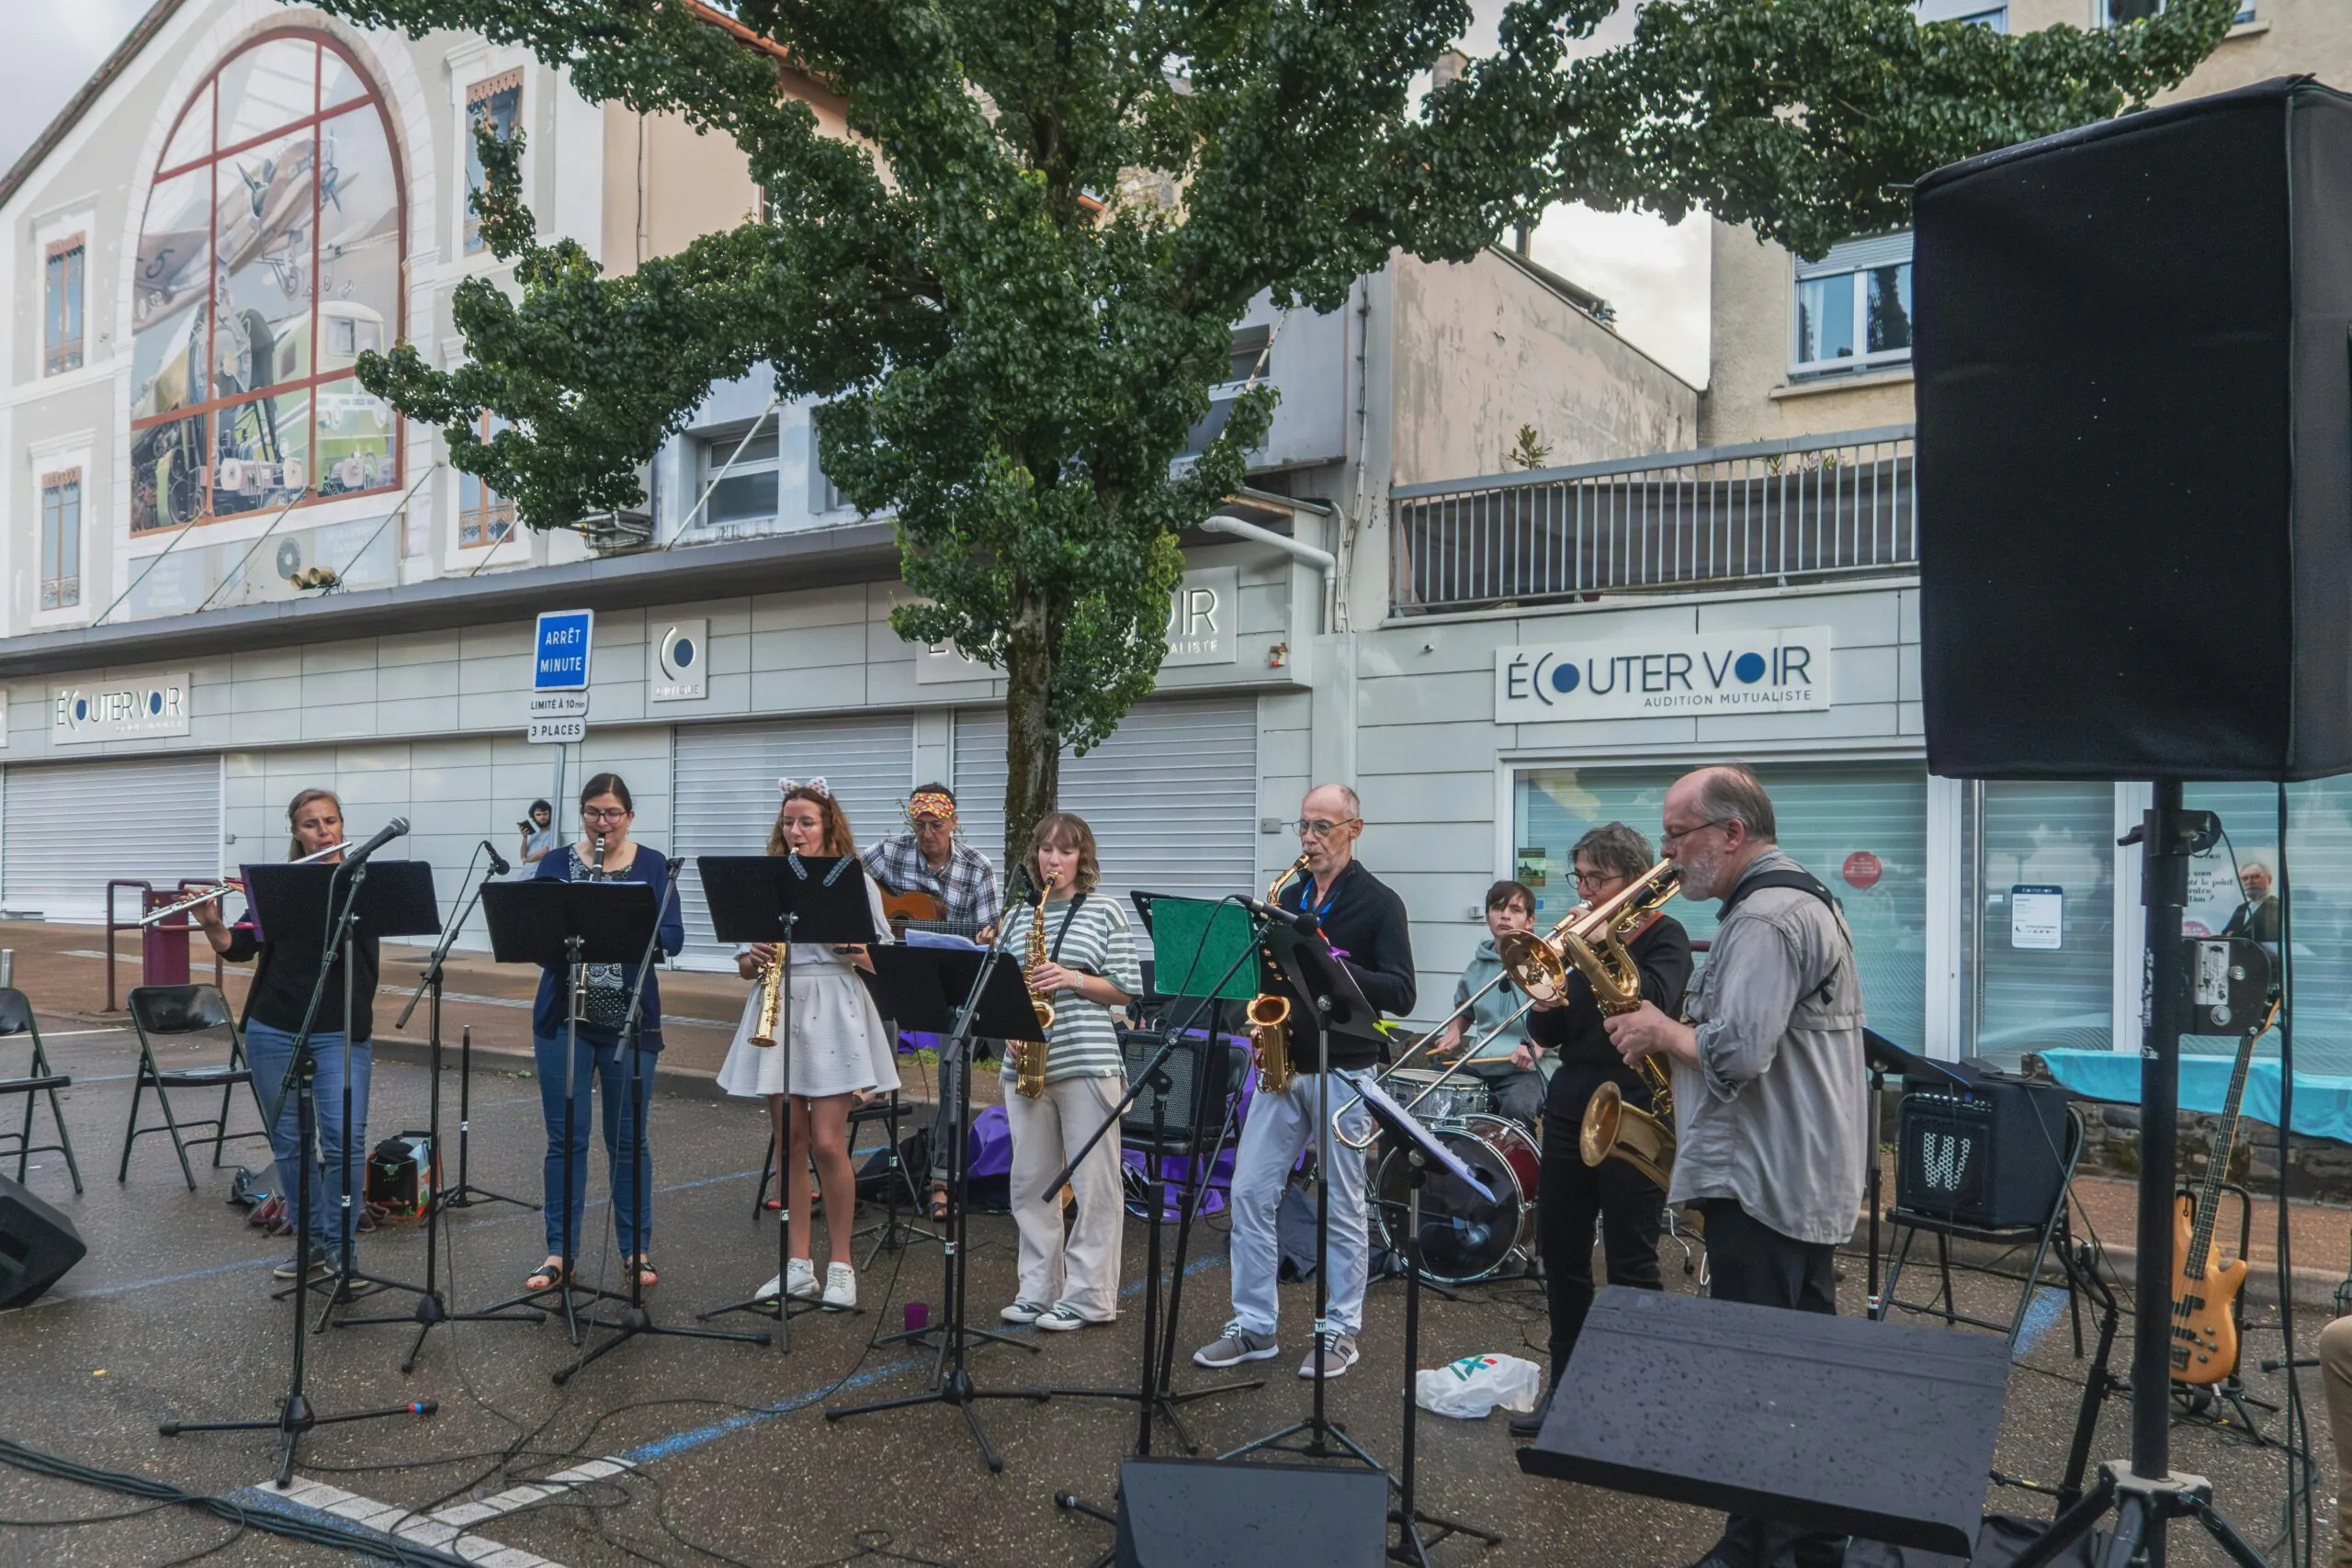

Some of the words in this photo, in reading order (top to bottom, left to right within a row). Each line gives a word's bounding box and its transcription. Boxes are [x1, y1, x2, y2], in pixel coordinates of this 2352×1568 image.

[1166, 589, 1218, 636] IR
[545, 626, 581, 646] ARRÊT
[1170, 640, 1218, 655] ALISTE
[540, 657, 582, 673] MINUTE
[1508, 652, 1693, 706] ÉCOUTER
[1702, 646, 1813, 688] VOIR
[530, 697, 556, 711] LIMITÉ
[558, 698, 564, 709] À
[1644, 694, 1713, 707] AUDITION
[1720, 691, 1813, 704] MUTUALISTE
[57, 690, 133, 730] ÉCOUTER
[137, 687, 184, 721] VOIR
[531, 726, 537, 737] 3
[541, 724, 581, 737] PLACES
[1924, 1132, 1971, 1191] W
